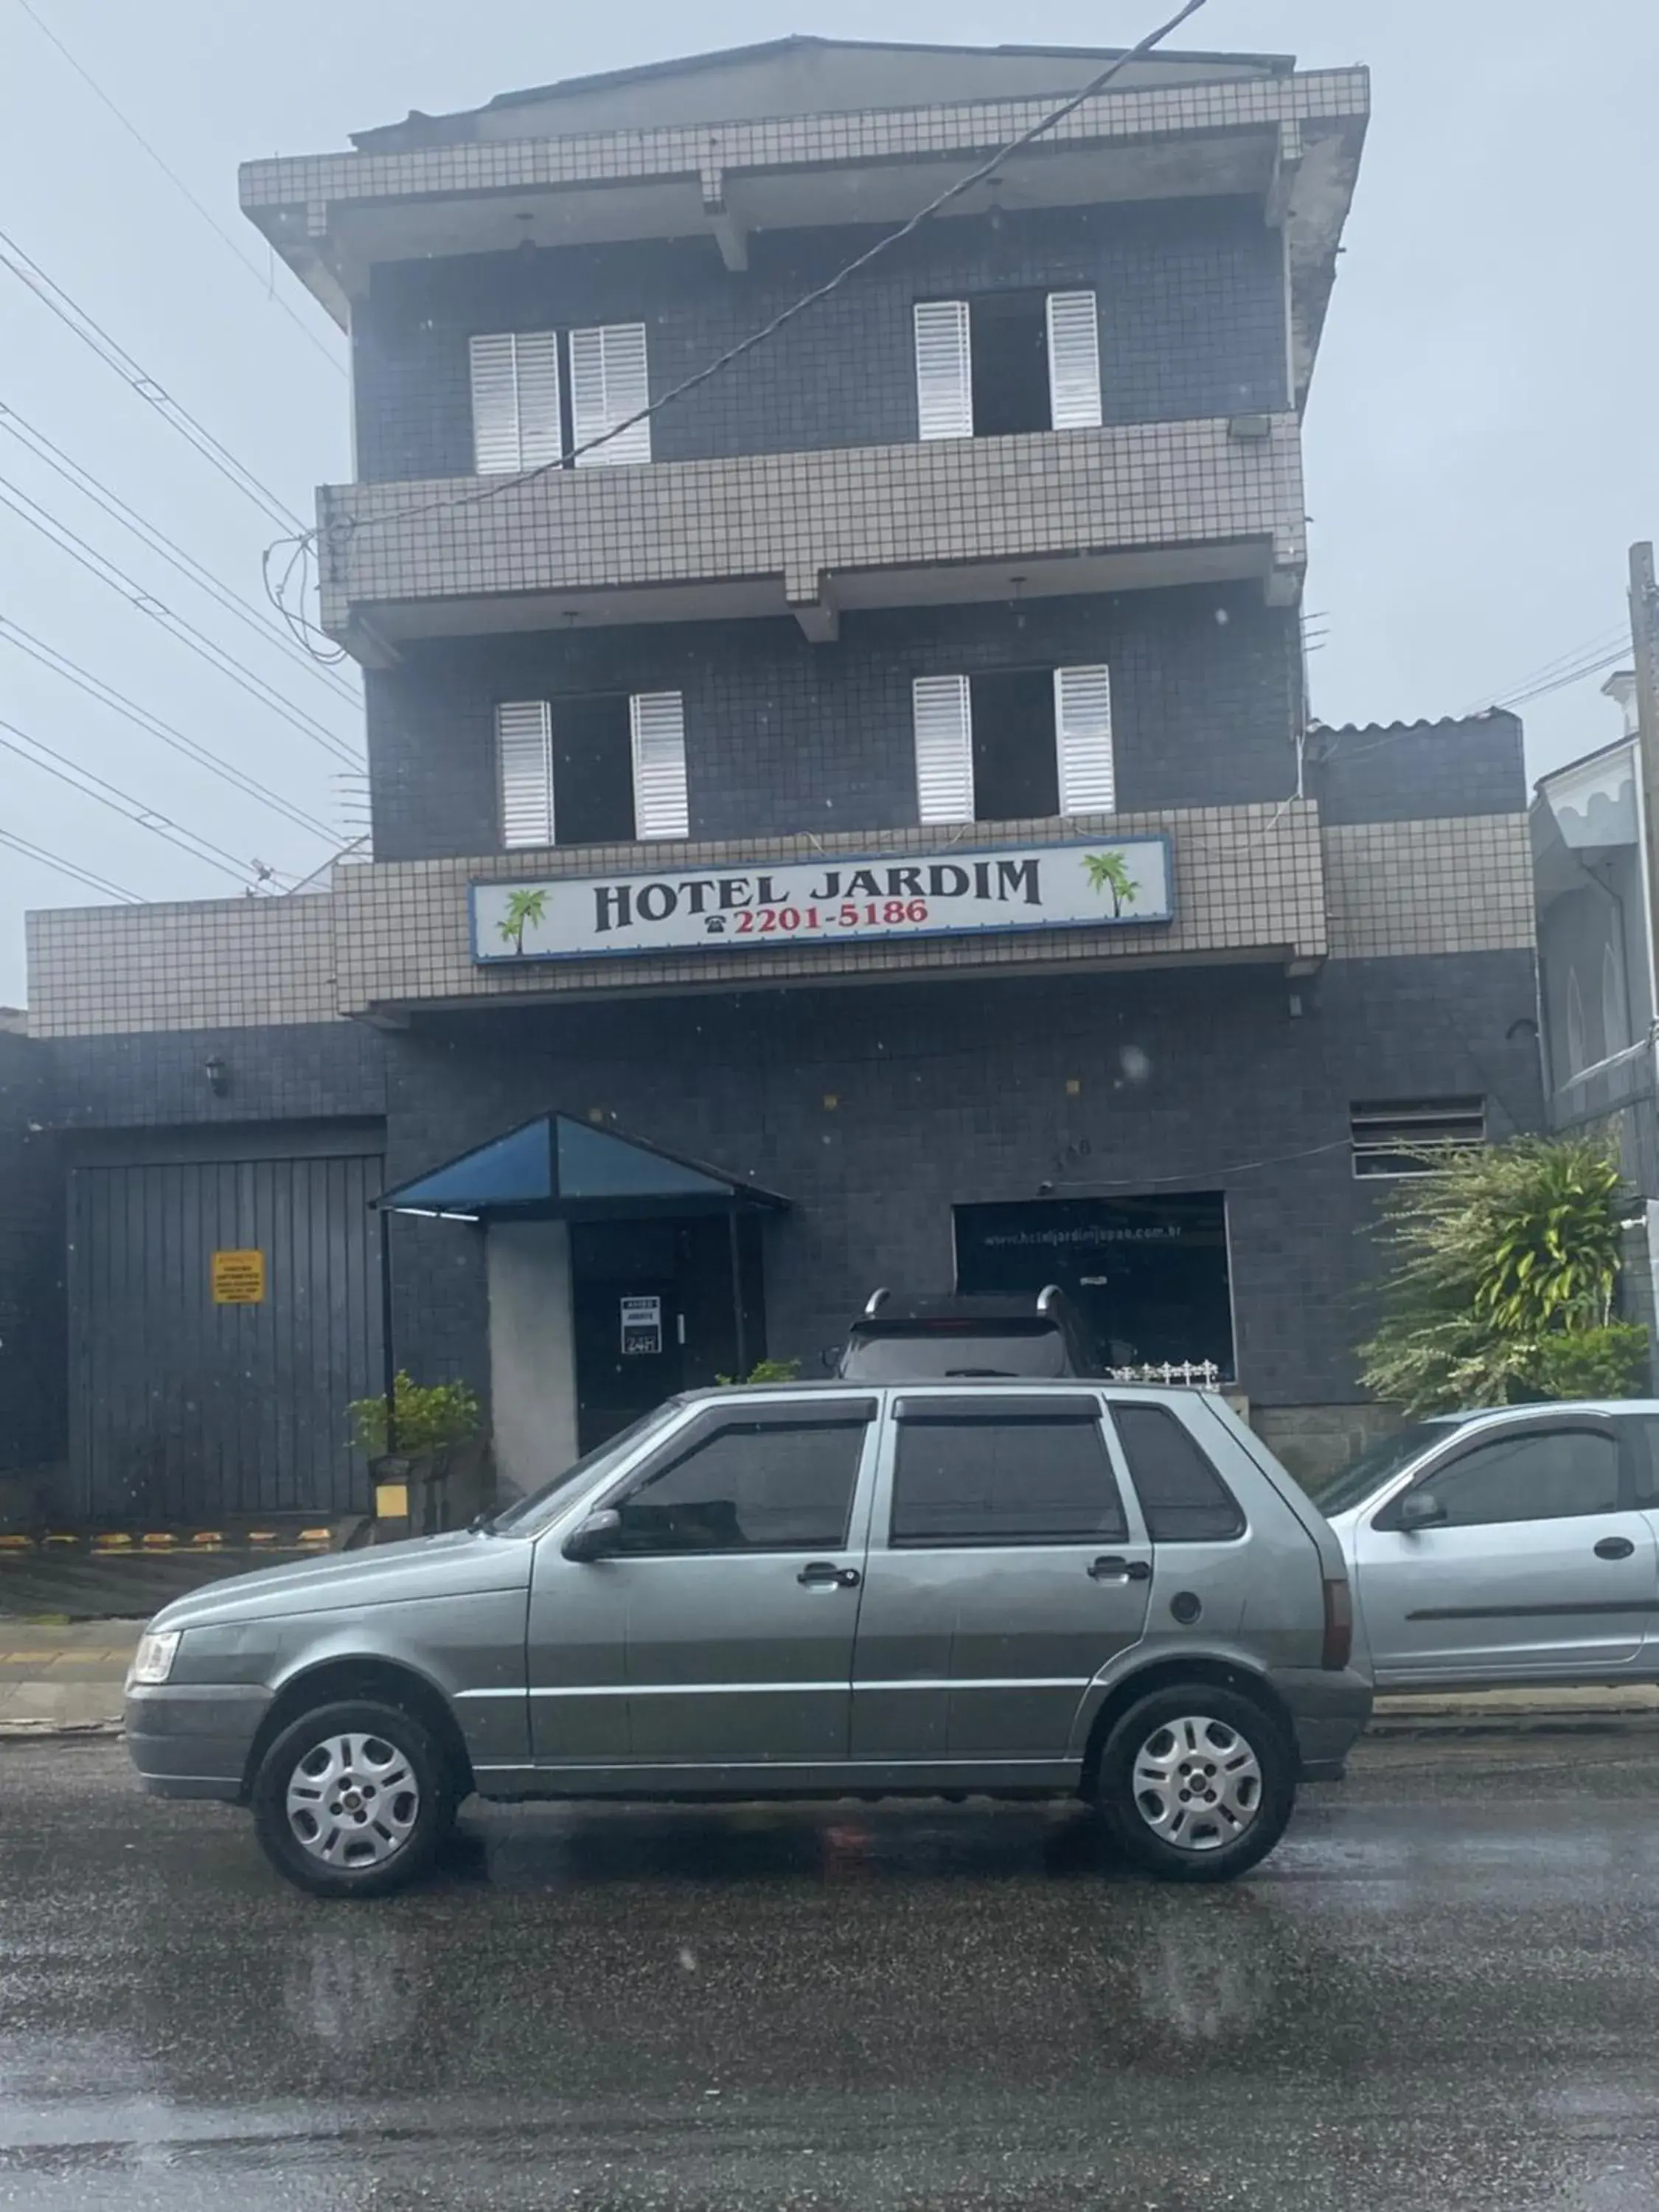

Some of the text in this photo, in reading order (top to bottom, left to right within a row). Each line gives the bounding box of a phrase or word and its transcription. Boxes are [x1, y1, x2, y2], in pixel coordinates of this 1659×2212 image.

[594, 858, 1042, 933] HOTEL JARDIM
[734, 899, 928, 934] 2201-5186
